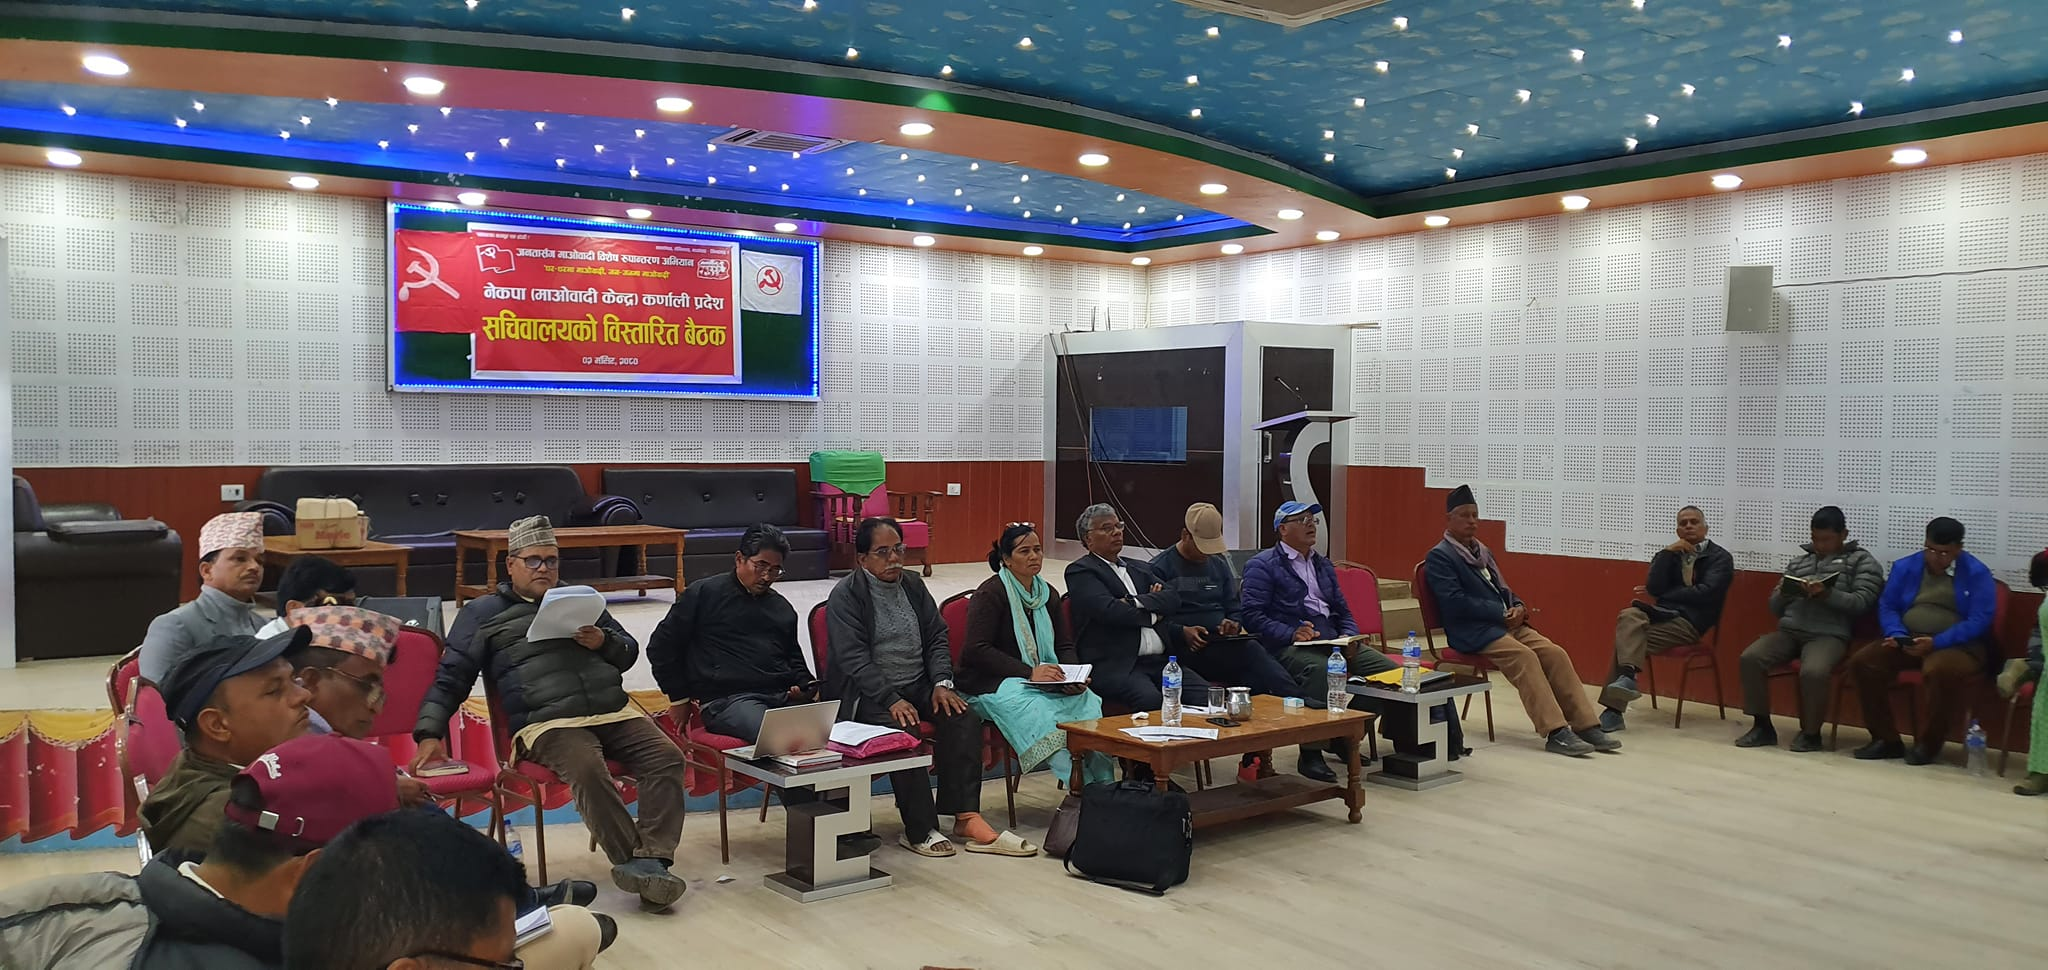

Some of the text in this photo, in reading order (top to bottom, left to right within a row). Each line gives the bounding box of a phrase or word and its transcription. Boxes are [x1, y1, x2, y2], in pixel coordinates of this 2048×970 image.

[557, 249, 595, 261] माओवादी
[597, 250, 619, 263] विशेष
[662, 255, 694, 267] अभियान
[483, 282, 724, 310] नेकपा (माओवादी केन्द्र) कर्णाली प्रदेश
[482, 309, 727, 346] सचिवालयको विस्तारित बैठक
